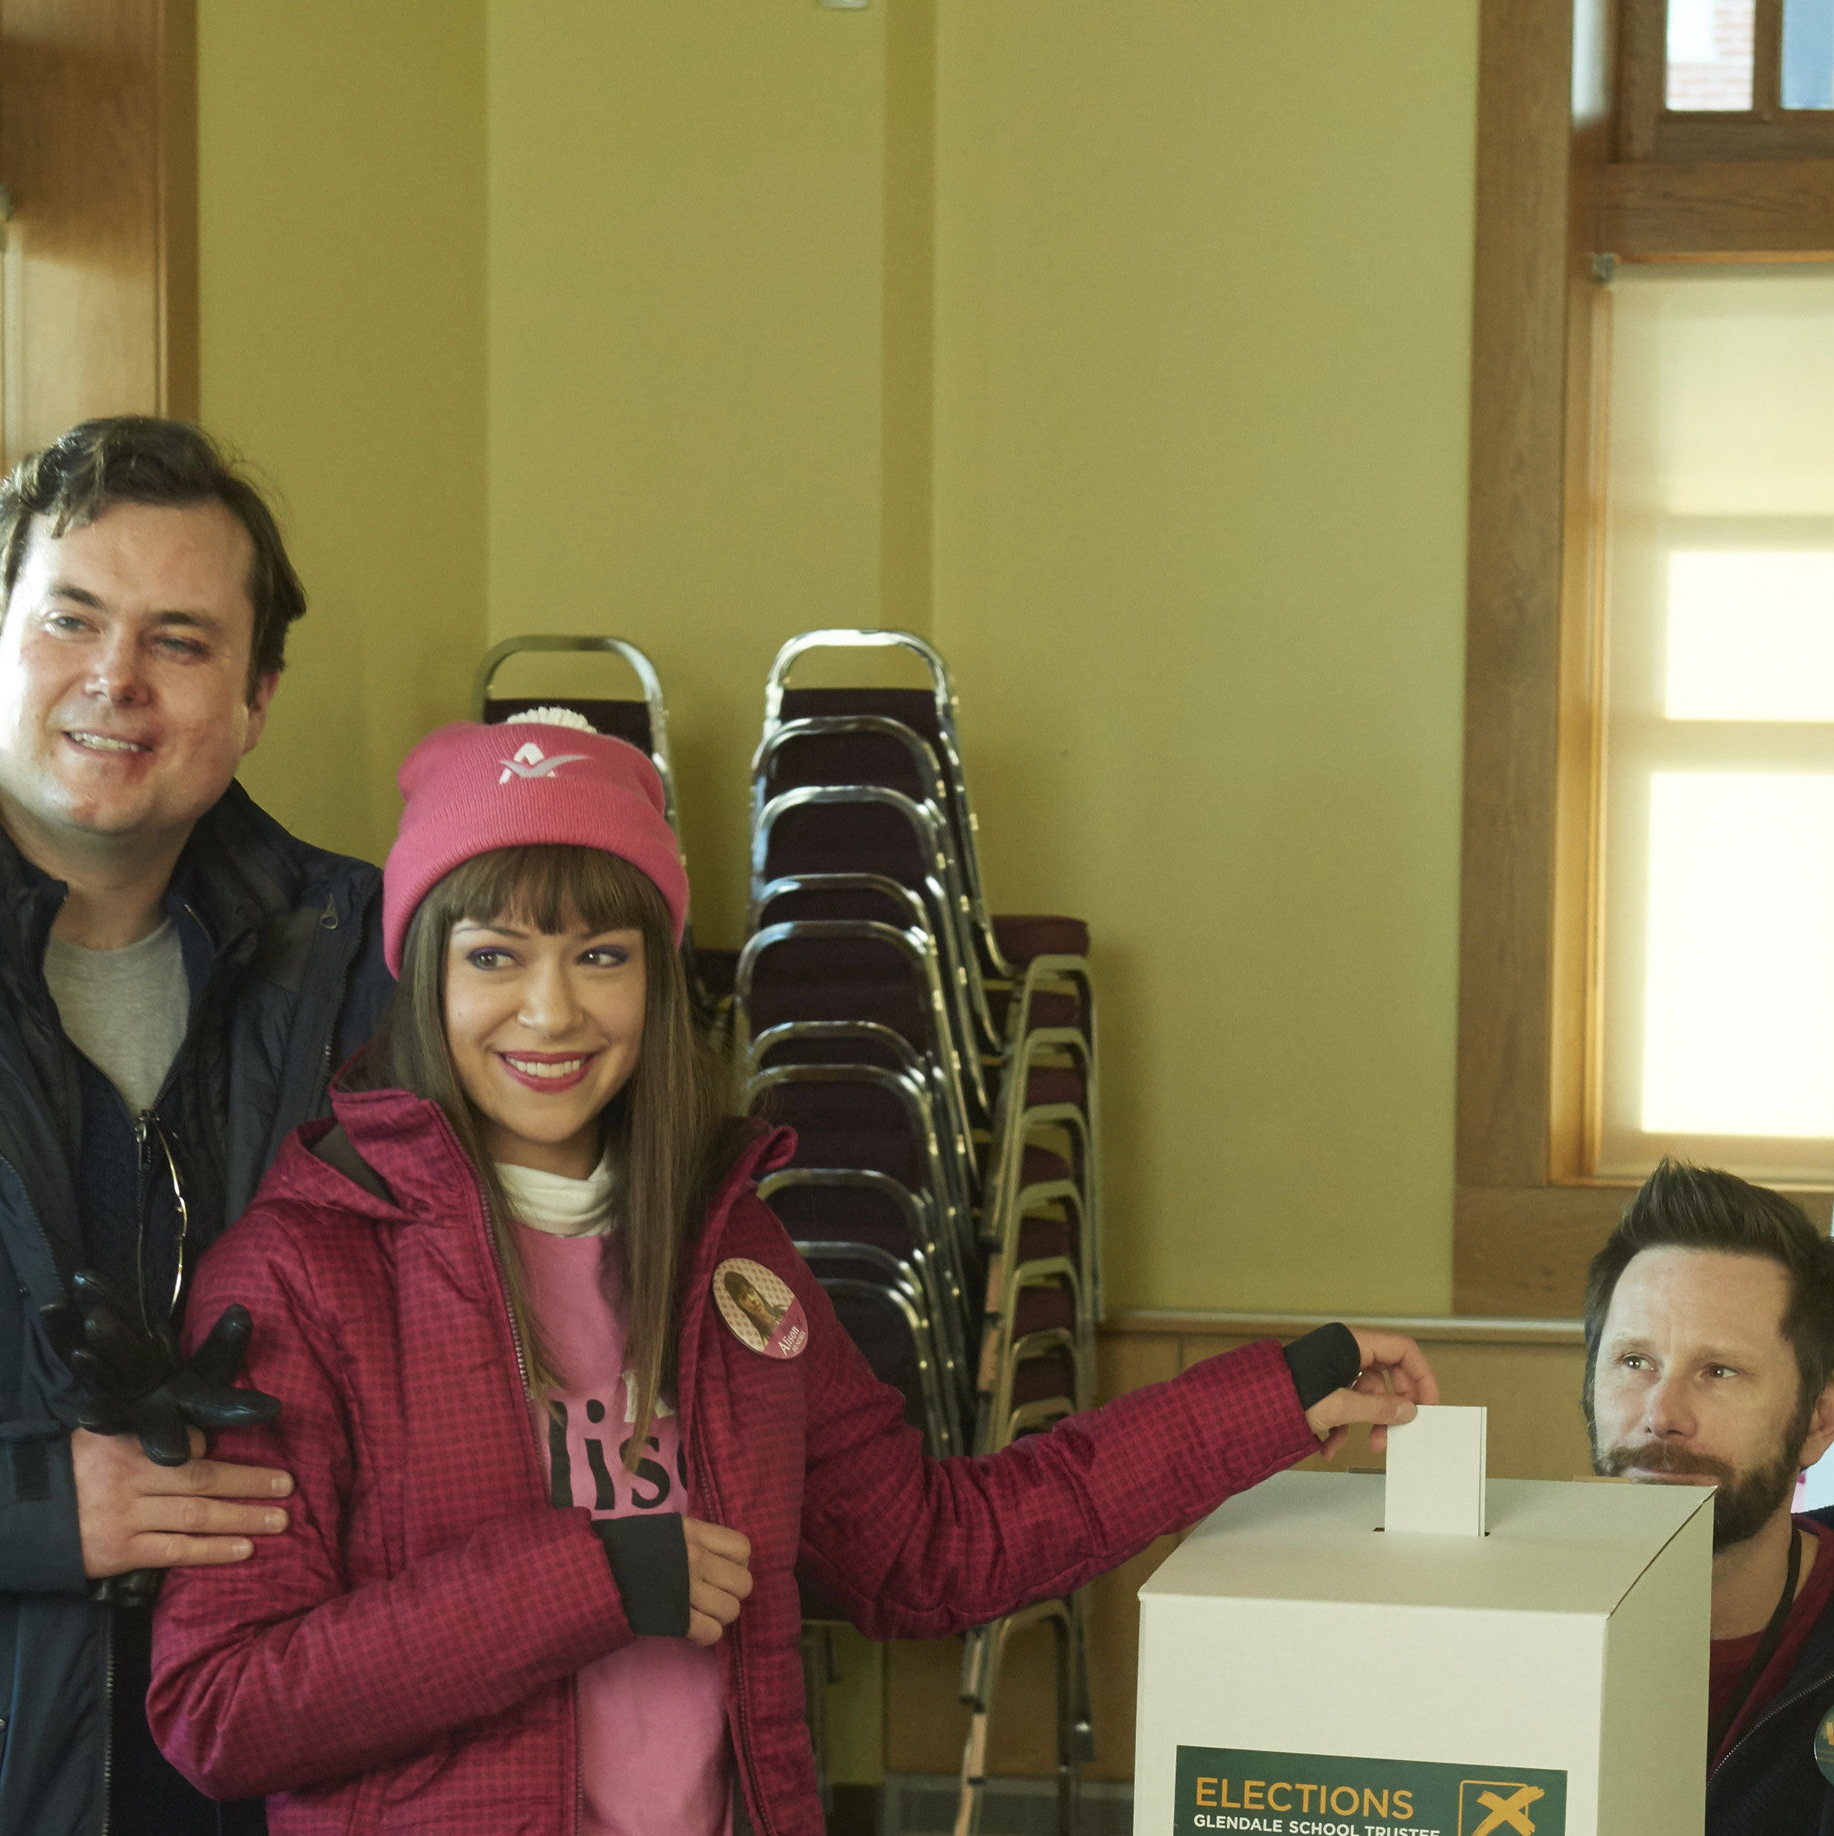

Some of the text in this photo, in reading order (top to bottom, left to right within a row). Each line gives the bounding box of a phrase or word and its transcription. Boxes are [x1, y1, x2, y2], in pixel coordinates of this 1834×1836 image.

[777, 1325, 800, 1356] Alison
[548, 1398, 688, 1510] lis
[1195, 1776, 1415, 1820] ELECTIONS
[1193, 1813, 1283, 1833] GLENDALE
